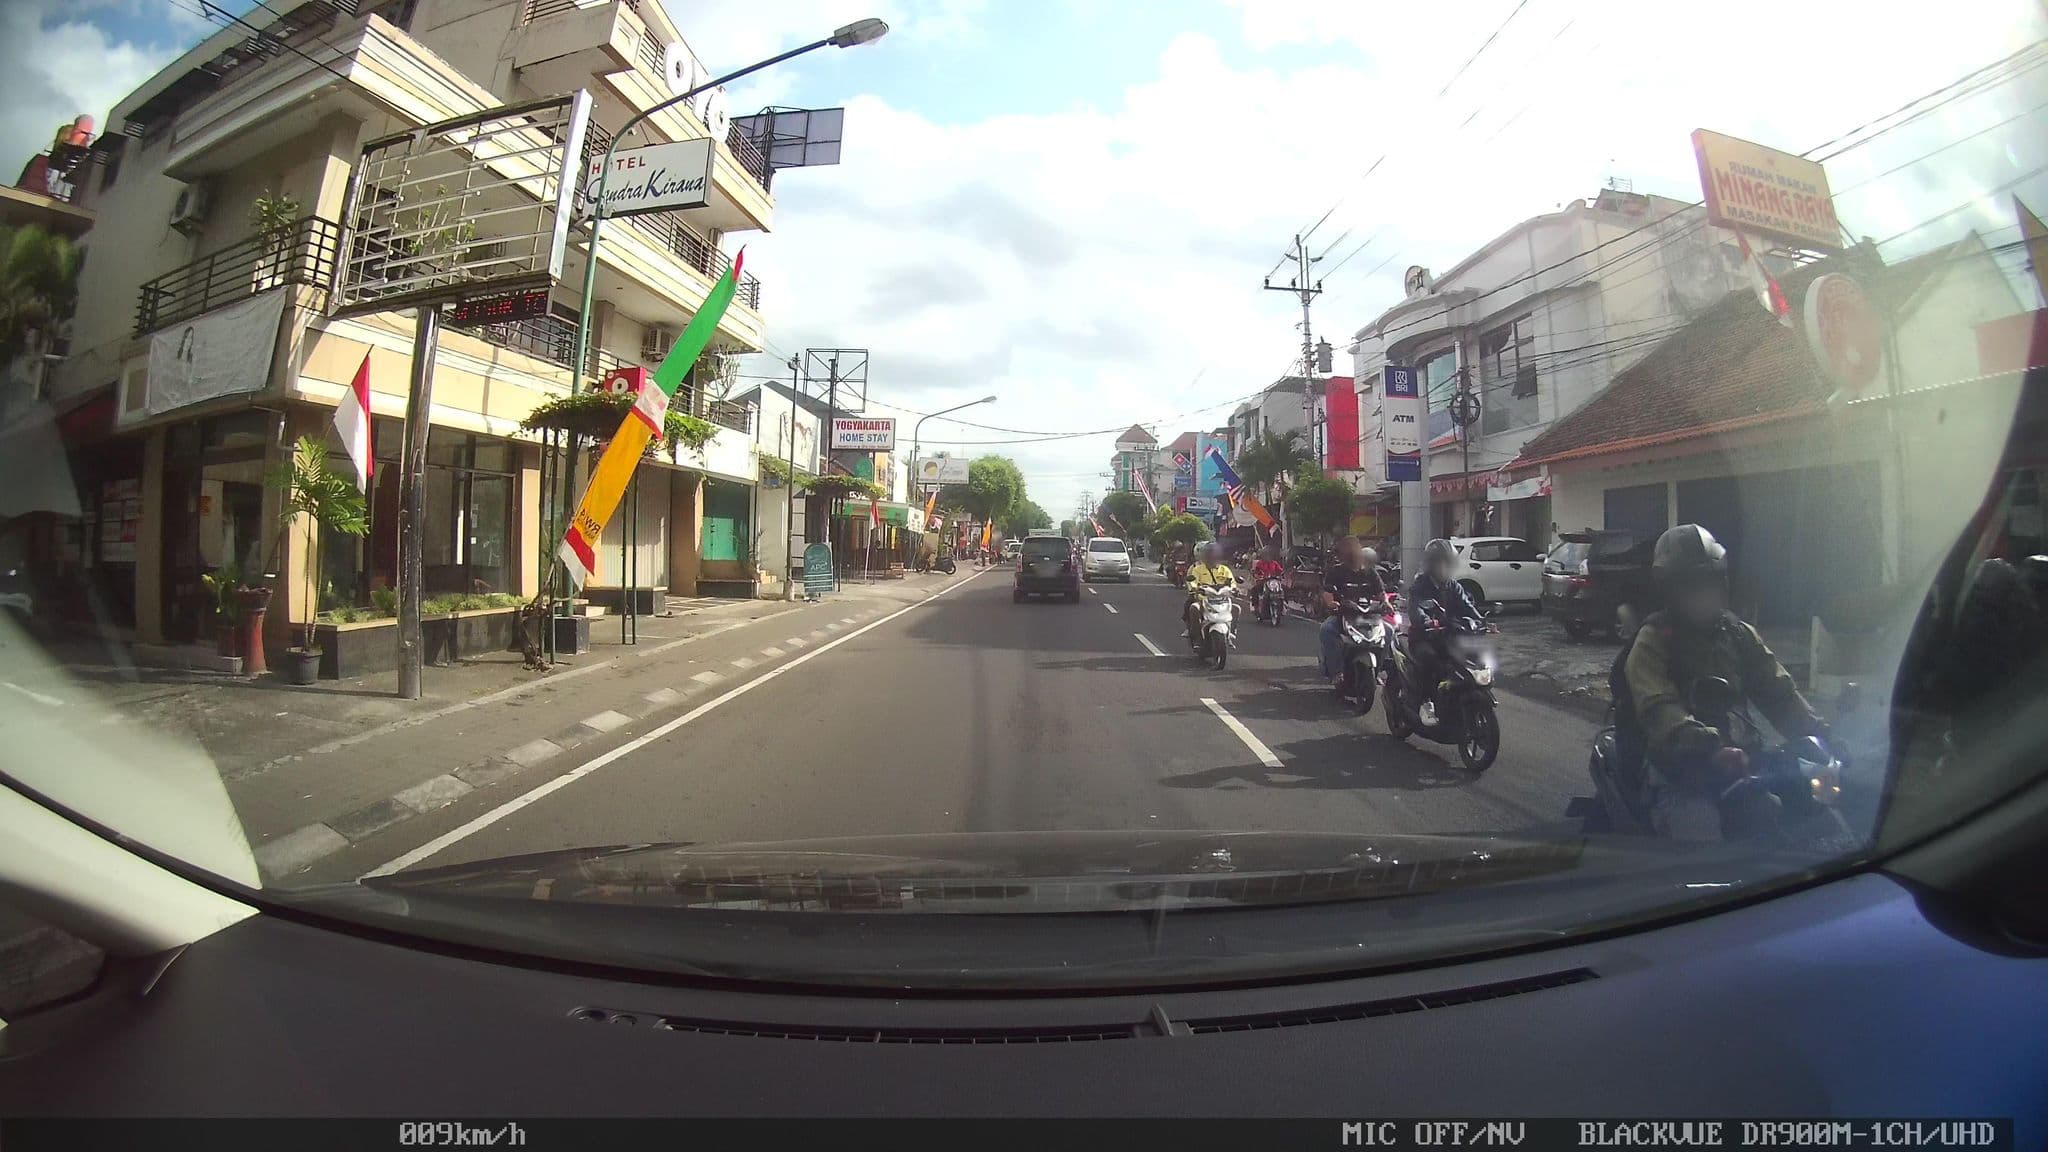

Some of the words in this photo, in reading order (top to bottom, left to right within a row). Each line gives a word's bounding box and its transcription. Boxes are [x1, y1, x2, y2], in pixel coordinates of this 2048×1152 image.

[592, 155, 646, 175] HTEL
[641, 168, 704, 200] Kirana
[1728, 161, 1774, 182] RUMAH
[1776, 174, 1817, 193] MAKAN
[1714, 168, 1793, 217] MINANG
[1727, 206, 1791, 229] MASAKAN
[1396, 384, 1408, 392] BRI
[835, 420, 891, 431] YOGYAKARTA
[1392, 414, 1415, 423] ATM
[840, 433, 864, 442] HOME
[867, 433, 888, 442] STAY
